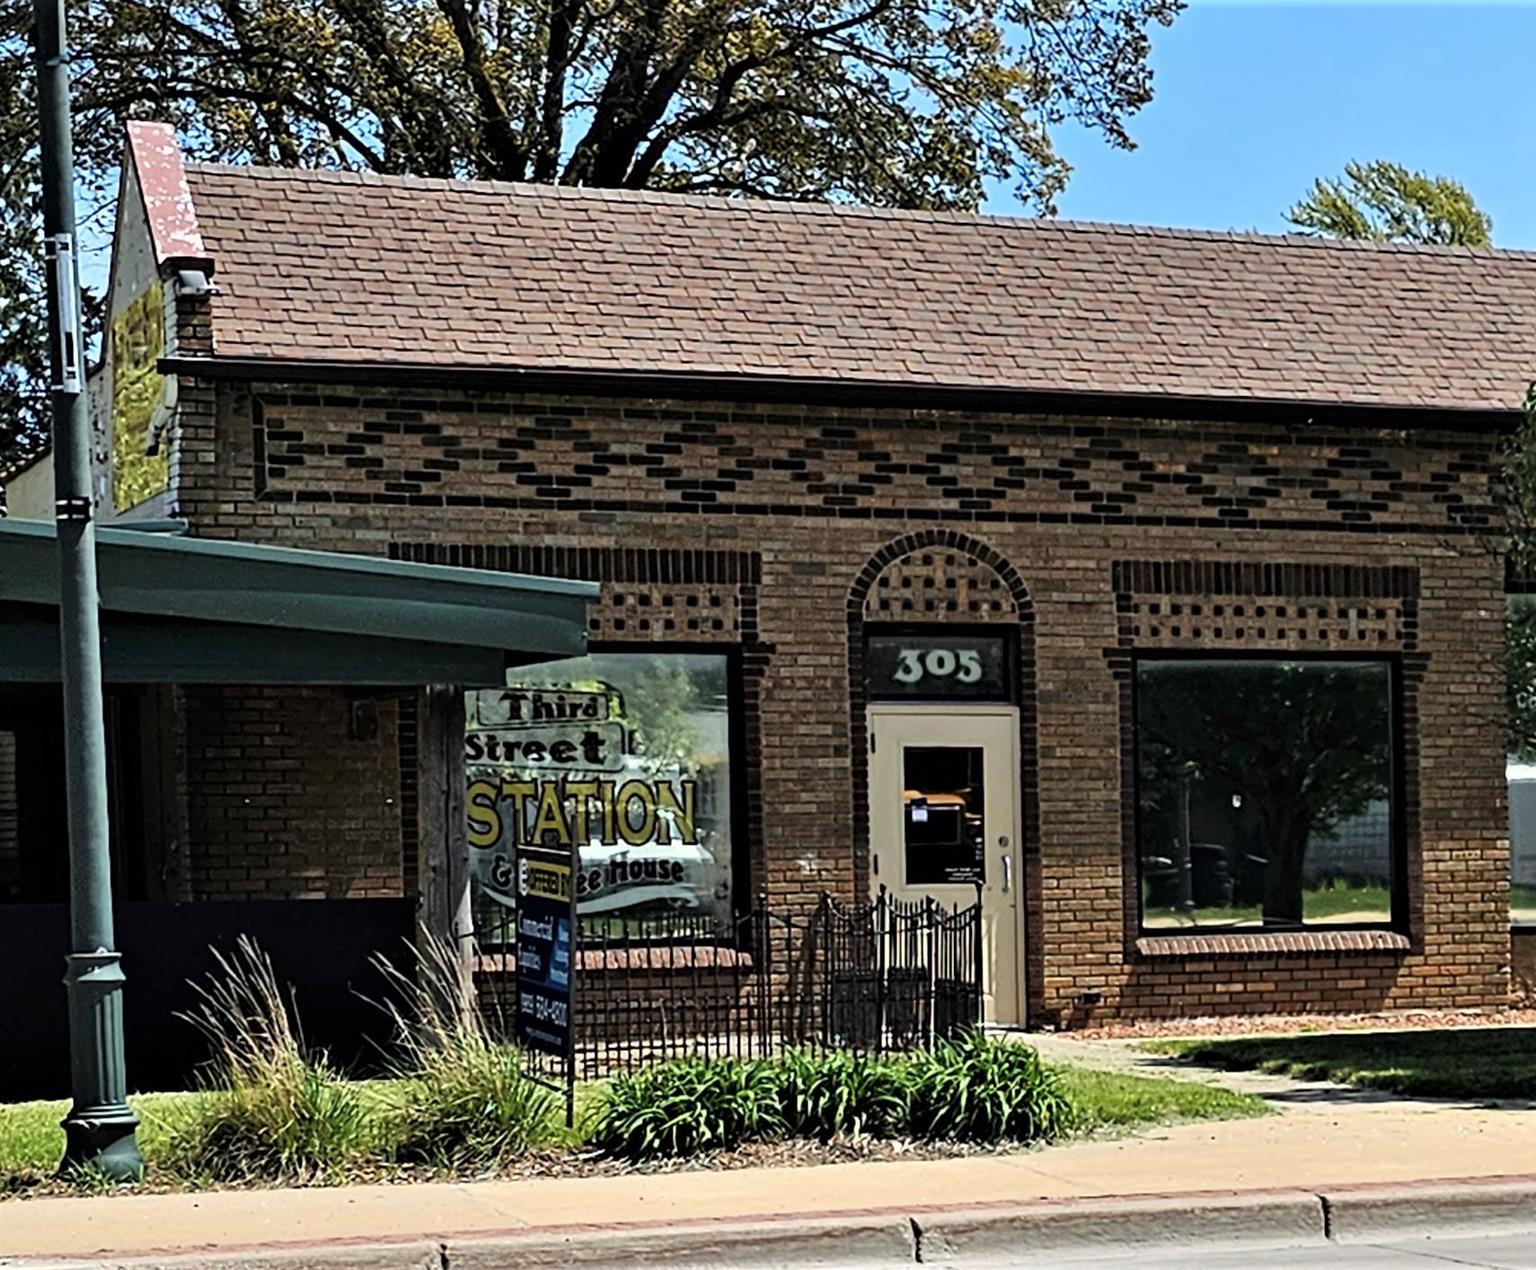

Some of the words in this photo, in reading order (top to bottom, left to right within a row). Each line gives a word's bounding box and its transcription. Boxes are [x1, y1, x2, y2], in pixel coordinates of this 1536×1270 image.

[894, 648, 982, 683] 305
[500, 692, 599, 720] Third
[465, 730, 607, 765] Street
[466, 777, 698, 848] STATION
[491, 854, 513, 890] &
